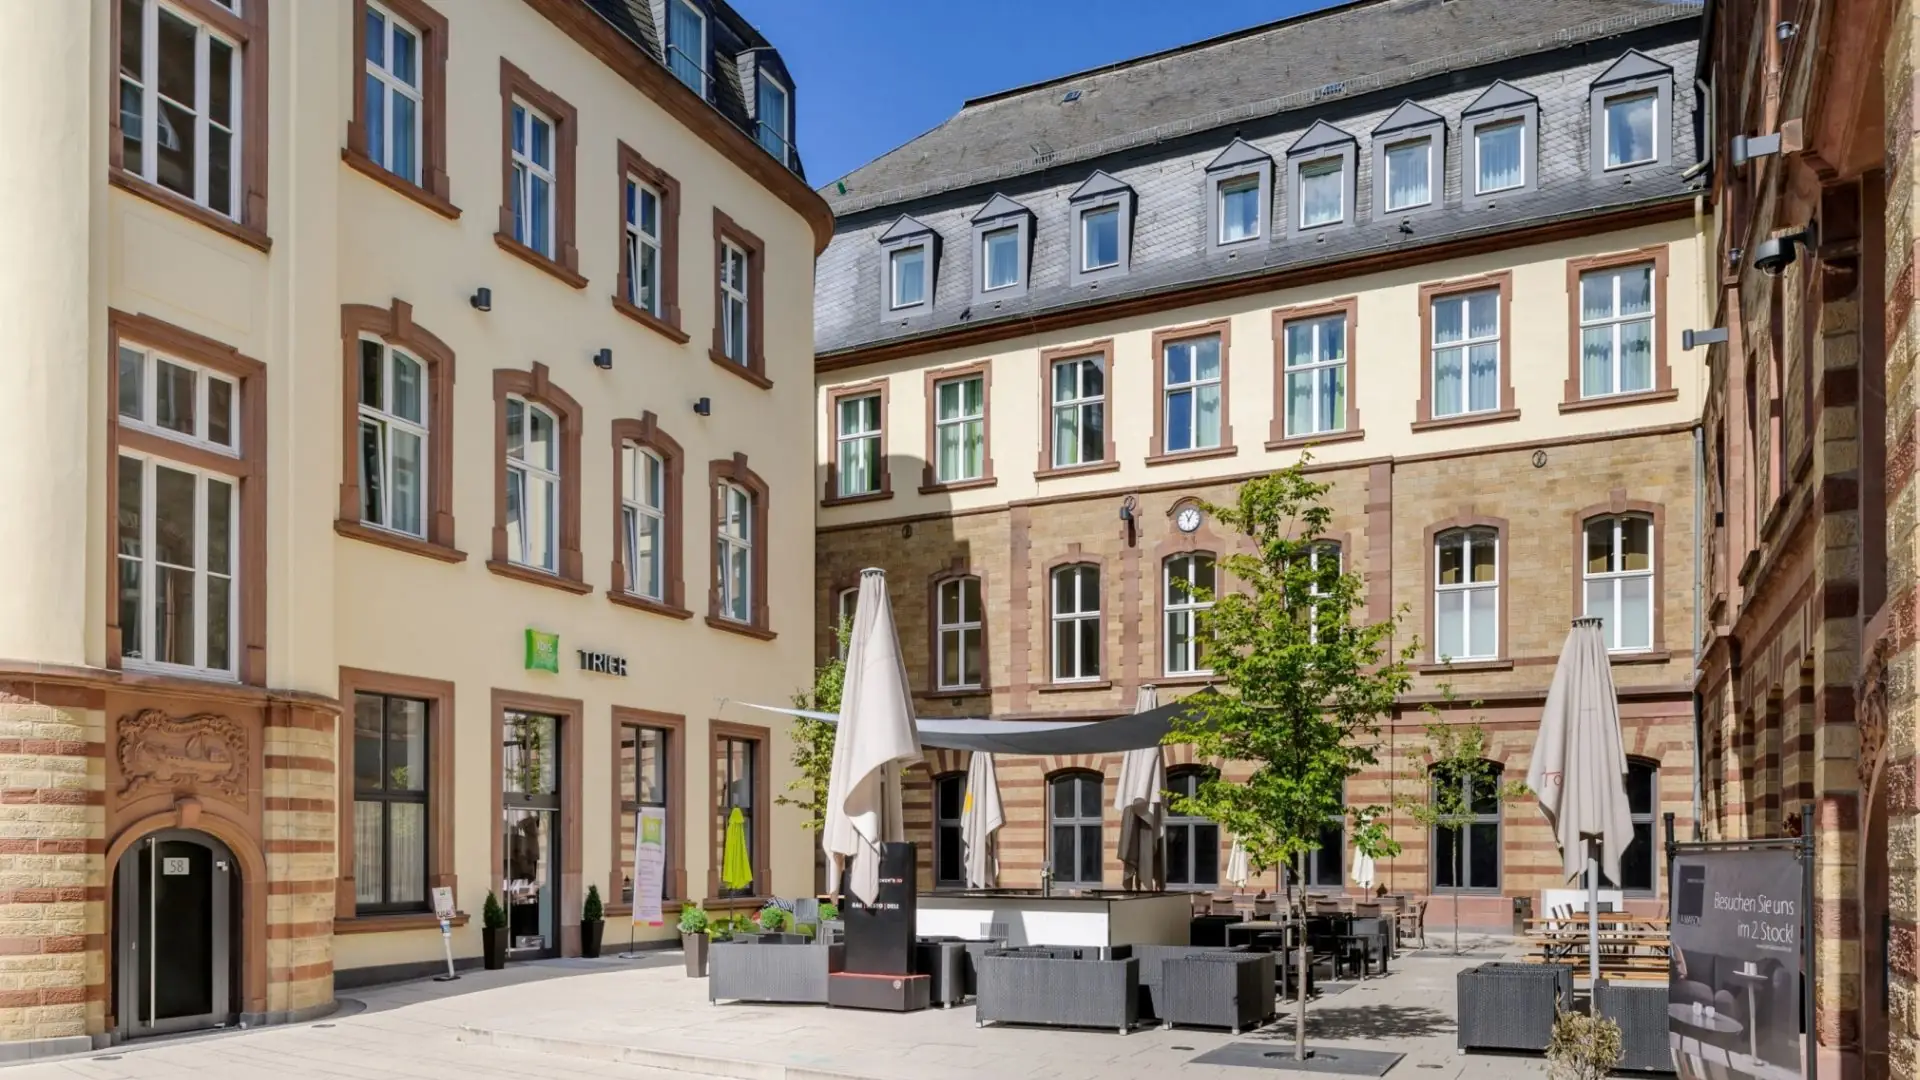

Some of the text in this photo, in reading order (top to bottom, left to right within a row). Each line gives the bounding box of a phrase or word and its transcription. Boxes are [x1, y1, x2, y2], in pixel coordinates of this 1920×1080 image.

[577, 649, 628, 677] TRIER
[169, 859, 184, 873] 58
[1714, 891, 1795, 915] Besuchen Sie uns
[1737, 919, 1750, 938] im
[1760, 920, 1794, 944] Stock!
